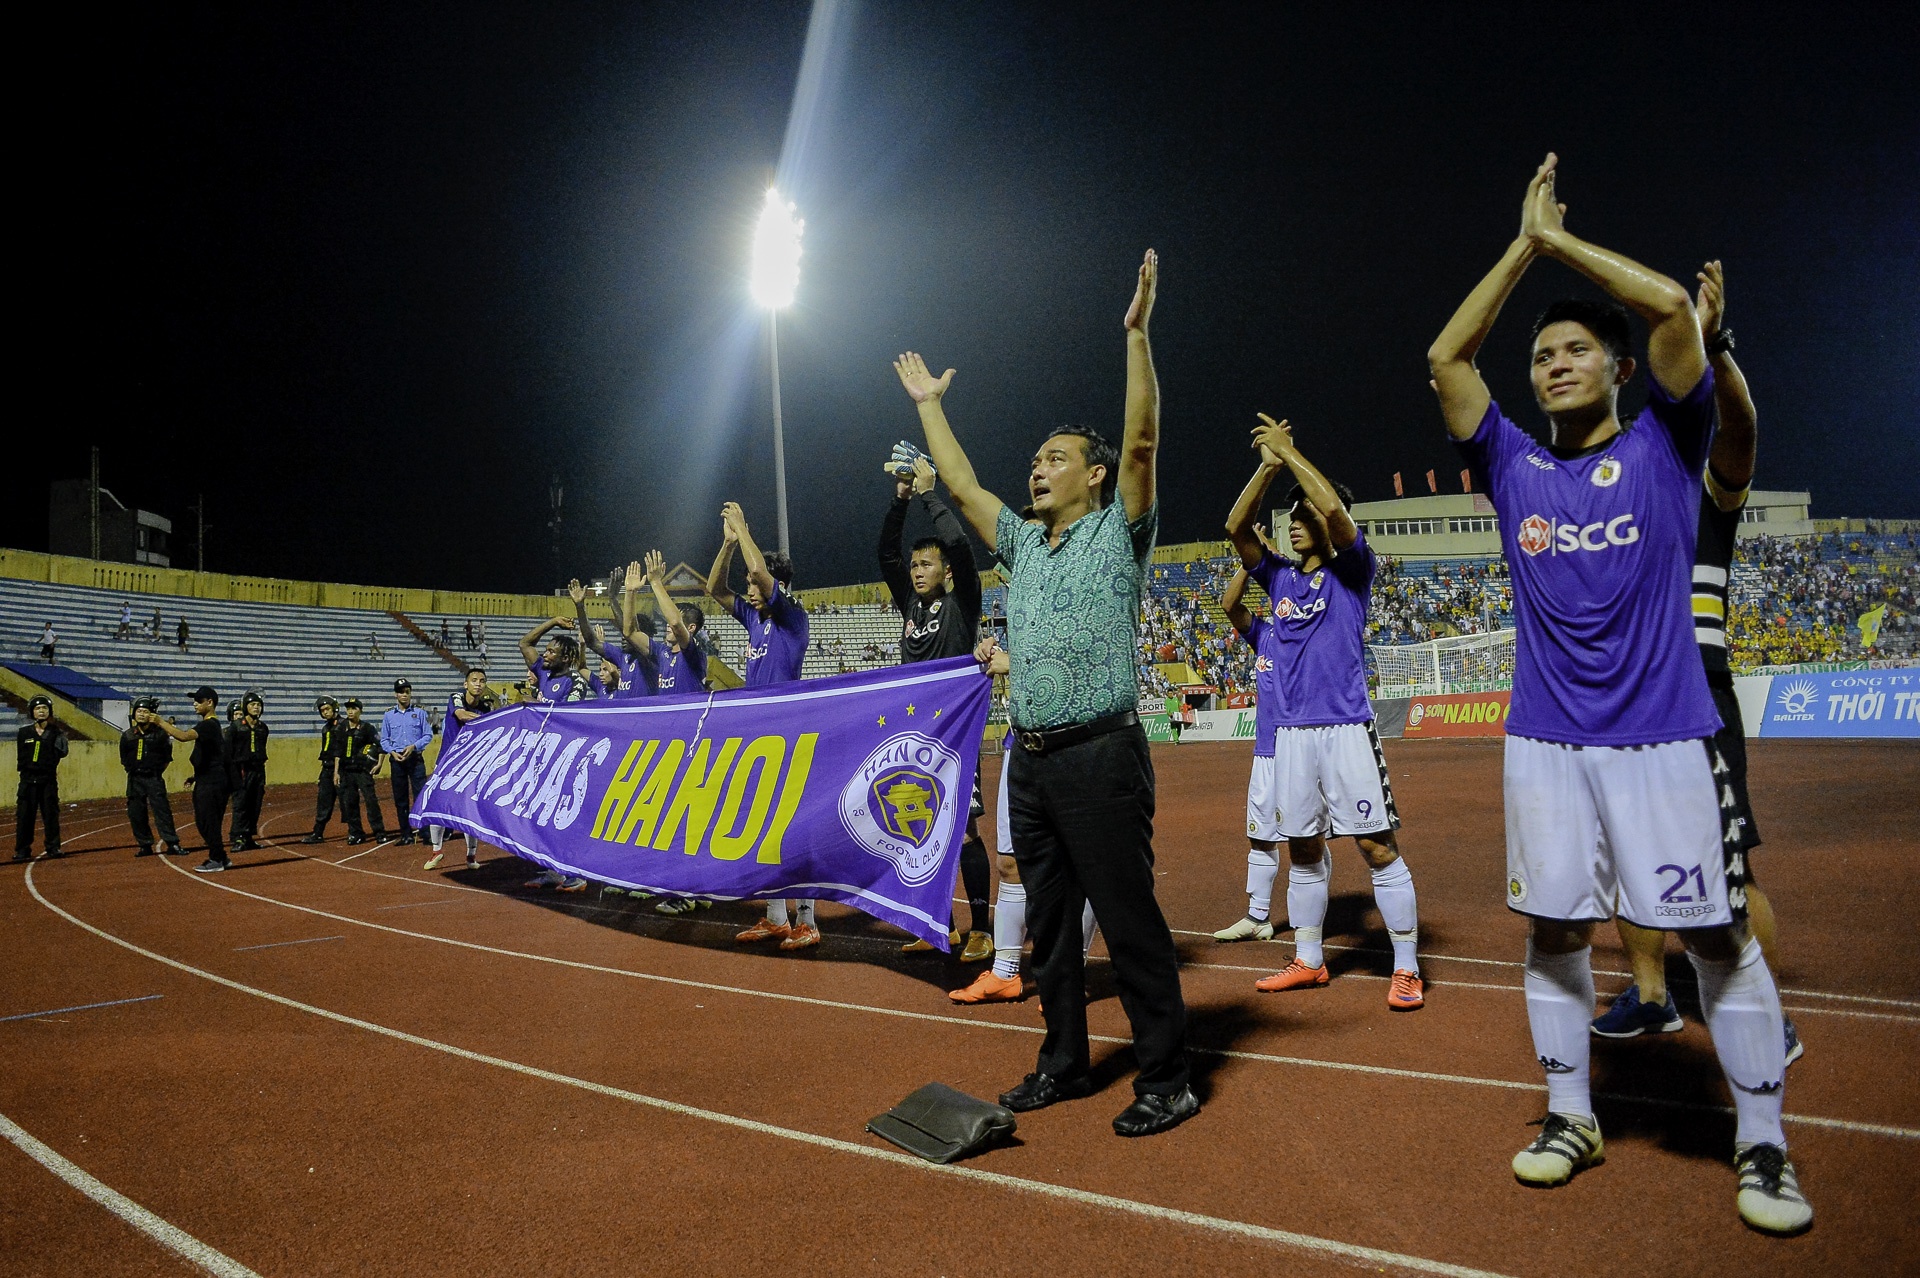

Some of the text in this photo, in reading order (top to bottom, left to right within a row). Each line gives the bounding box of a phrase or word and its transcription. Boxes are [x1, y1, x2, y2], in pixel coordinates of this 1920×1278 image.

[1557, 514, 1640, 552] SCG
[1831, 675, 1914, 688] CÔNG TY
[1443, 702, 1501, 724] NANO
[1773, 713, 1815, 722] BALITEX
[1827, 687, 1887, 724] THỜI
[864, 742, 948, 783] HANOI
[590, 732, 820, 865] HANOI
[1356, 799, 1372, 821] 9
[852, 808, 865, 817] 20
[922, 839, 941, 866] CLUB
[1653, 862, 1708, 904] 21
[1655, 904, 1717, 918] Kappa
